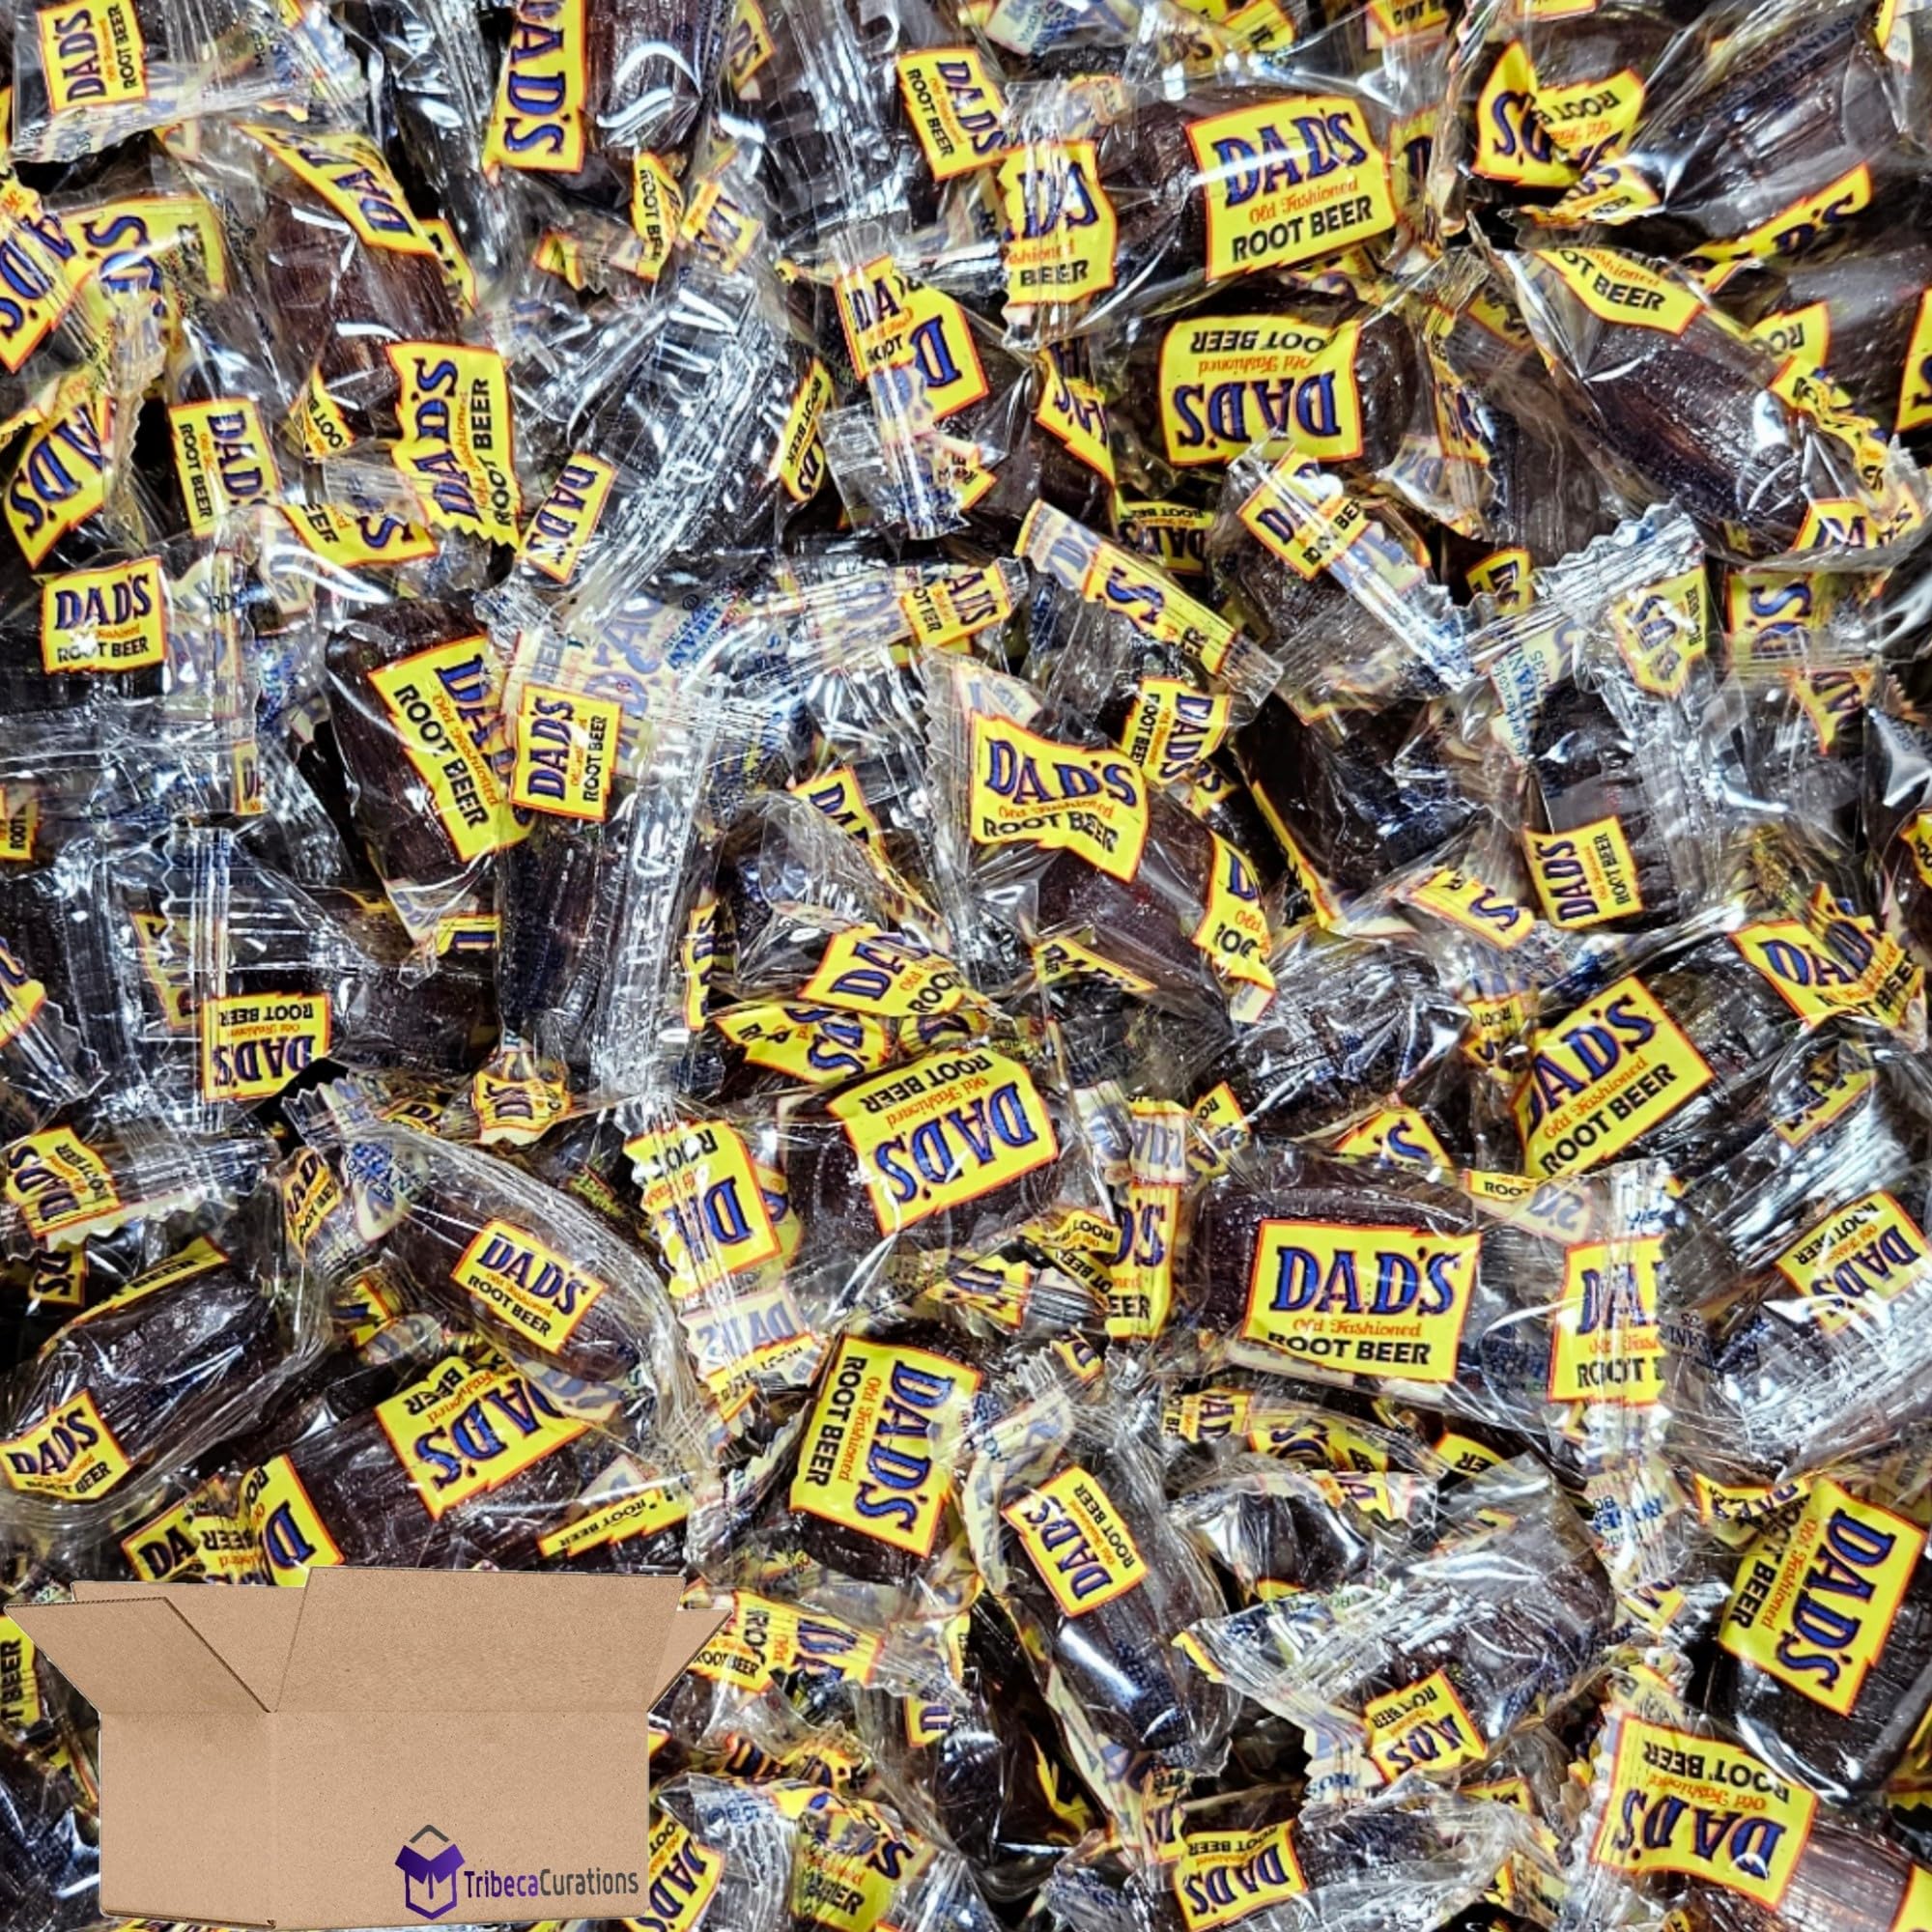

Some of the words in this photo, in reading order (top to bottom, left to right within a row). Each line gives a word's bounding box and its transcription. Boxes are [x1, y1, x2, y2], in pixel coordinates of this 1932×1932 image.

[54, 9, 107, 102] DAD'S
[107, 5, 129, 45] BEER
[117, 47, 139, 89] ROOT
[906, 68, 936, 113] ROOT
[926, 112, 955, 159] BEER
[936, 60, 1007, 155] DAD'S
[1211, 108, 1369, 210] DAD'S
[1232, 215, 1305, 263] ROOT
[1309, 194, 1374, 231] BEER
[1249, 203, 1278, 226] Old
[1281, 180, 1359, 214] Fashioned
[1592, 275, 1666, 312] BEER
[1190, 329, 1260, 354] BEER
[412, 357, 485, 525] DAD'S
[471, 378, 495, 450] BEER
[1172, 370, 1343, 449] DAD'S
[179, 423, 201, 470] ROOT
[190, 469, 214, 519] BEER
[55, 573, 153, 629] DAD'S
[111, 636, 150, 658] BEER
[392, 683, 457, 758] ROOT
[440, 757, 492, 831] BEER
[527, 696, 578, 801] DAD'S
[588, 715, 609, 752] BEER
[582, 752, 605, 803] ROOT
[984, 735, 1139, 809] DAD'S
[983, 811, 1063, 838] ROOT
[1066, 810, 1120, 855] BEER
[1536, 839, 1601, 922] DAD'S
[219, 1006, 260, 1027] BEER
[264, 1003, 315, 1021] ROOT
[213, 1036, 318, 1088] DAD'S
[925, 1054, 995, 1085] ROOT
[859, 1081, 925, 1115] BEER
[1538, 1114, 1610, 1176] ROOT
[1607, 1063, 1679, 1122] BEER
[1544, 1112, 1572, 1140] Old
[1573, 1056, 1649, 1119] Fashioned
[874, 1080, 1038, 1206] DAD'S
[467, 1273, 511, 1314] ROOT
[509, 1300, 554, 1338] BEER
[476, 1230, 590, 1316] DAD'S
[1268, 1243, 1463, 1317] DAD'S
[1268, 1331, 1352, 1360] ROOT
[1355, 1340, 1432, 1365] BEER
[1293, 1318, 1324, 1333] Old
[1328, 1318, 1422, 1338] Fashioned
[827, 1355, 868, 1425] ROOT
[868, 1377, 883, 1406] Old
[7, 1406, 99, 1476] DAD'S
[805, 1423, 845, 1488] BEER
[838, 1406, 873, 1482] Fashioned
[855, 1359, 955, 1533] DAD'S
[75, 1461, 113, 1493] BEER
[1072, 1483, 1106, 1523] BEER
[1022, 1494, 1114, 1600] DAD'S
[1104, 1522, 1135, 1570] ROOT
[1728, 1559, 1777, 1630] BEER
[1759, 1548, 1806, 1631] Fashioned
[1776, 1507, 1898, 1692] DAD'S
[1641, 1740, 1707, 1779] BEER
[649, 1821, 676, 1857] OOT
[1188, 1840, 1232, 1857] BEER
[1611, 1787, 1788, 1881] DAD'S
[1183, 1843, 1291, 1916] DAD'S
